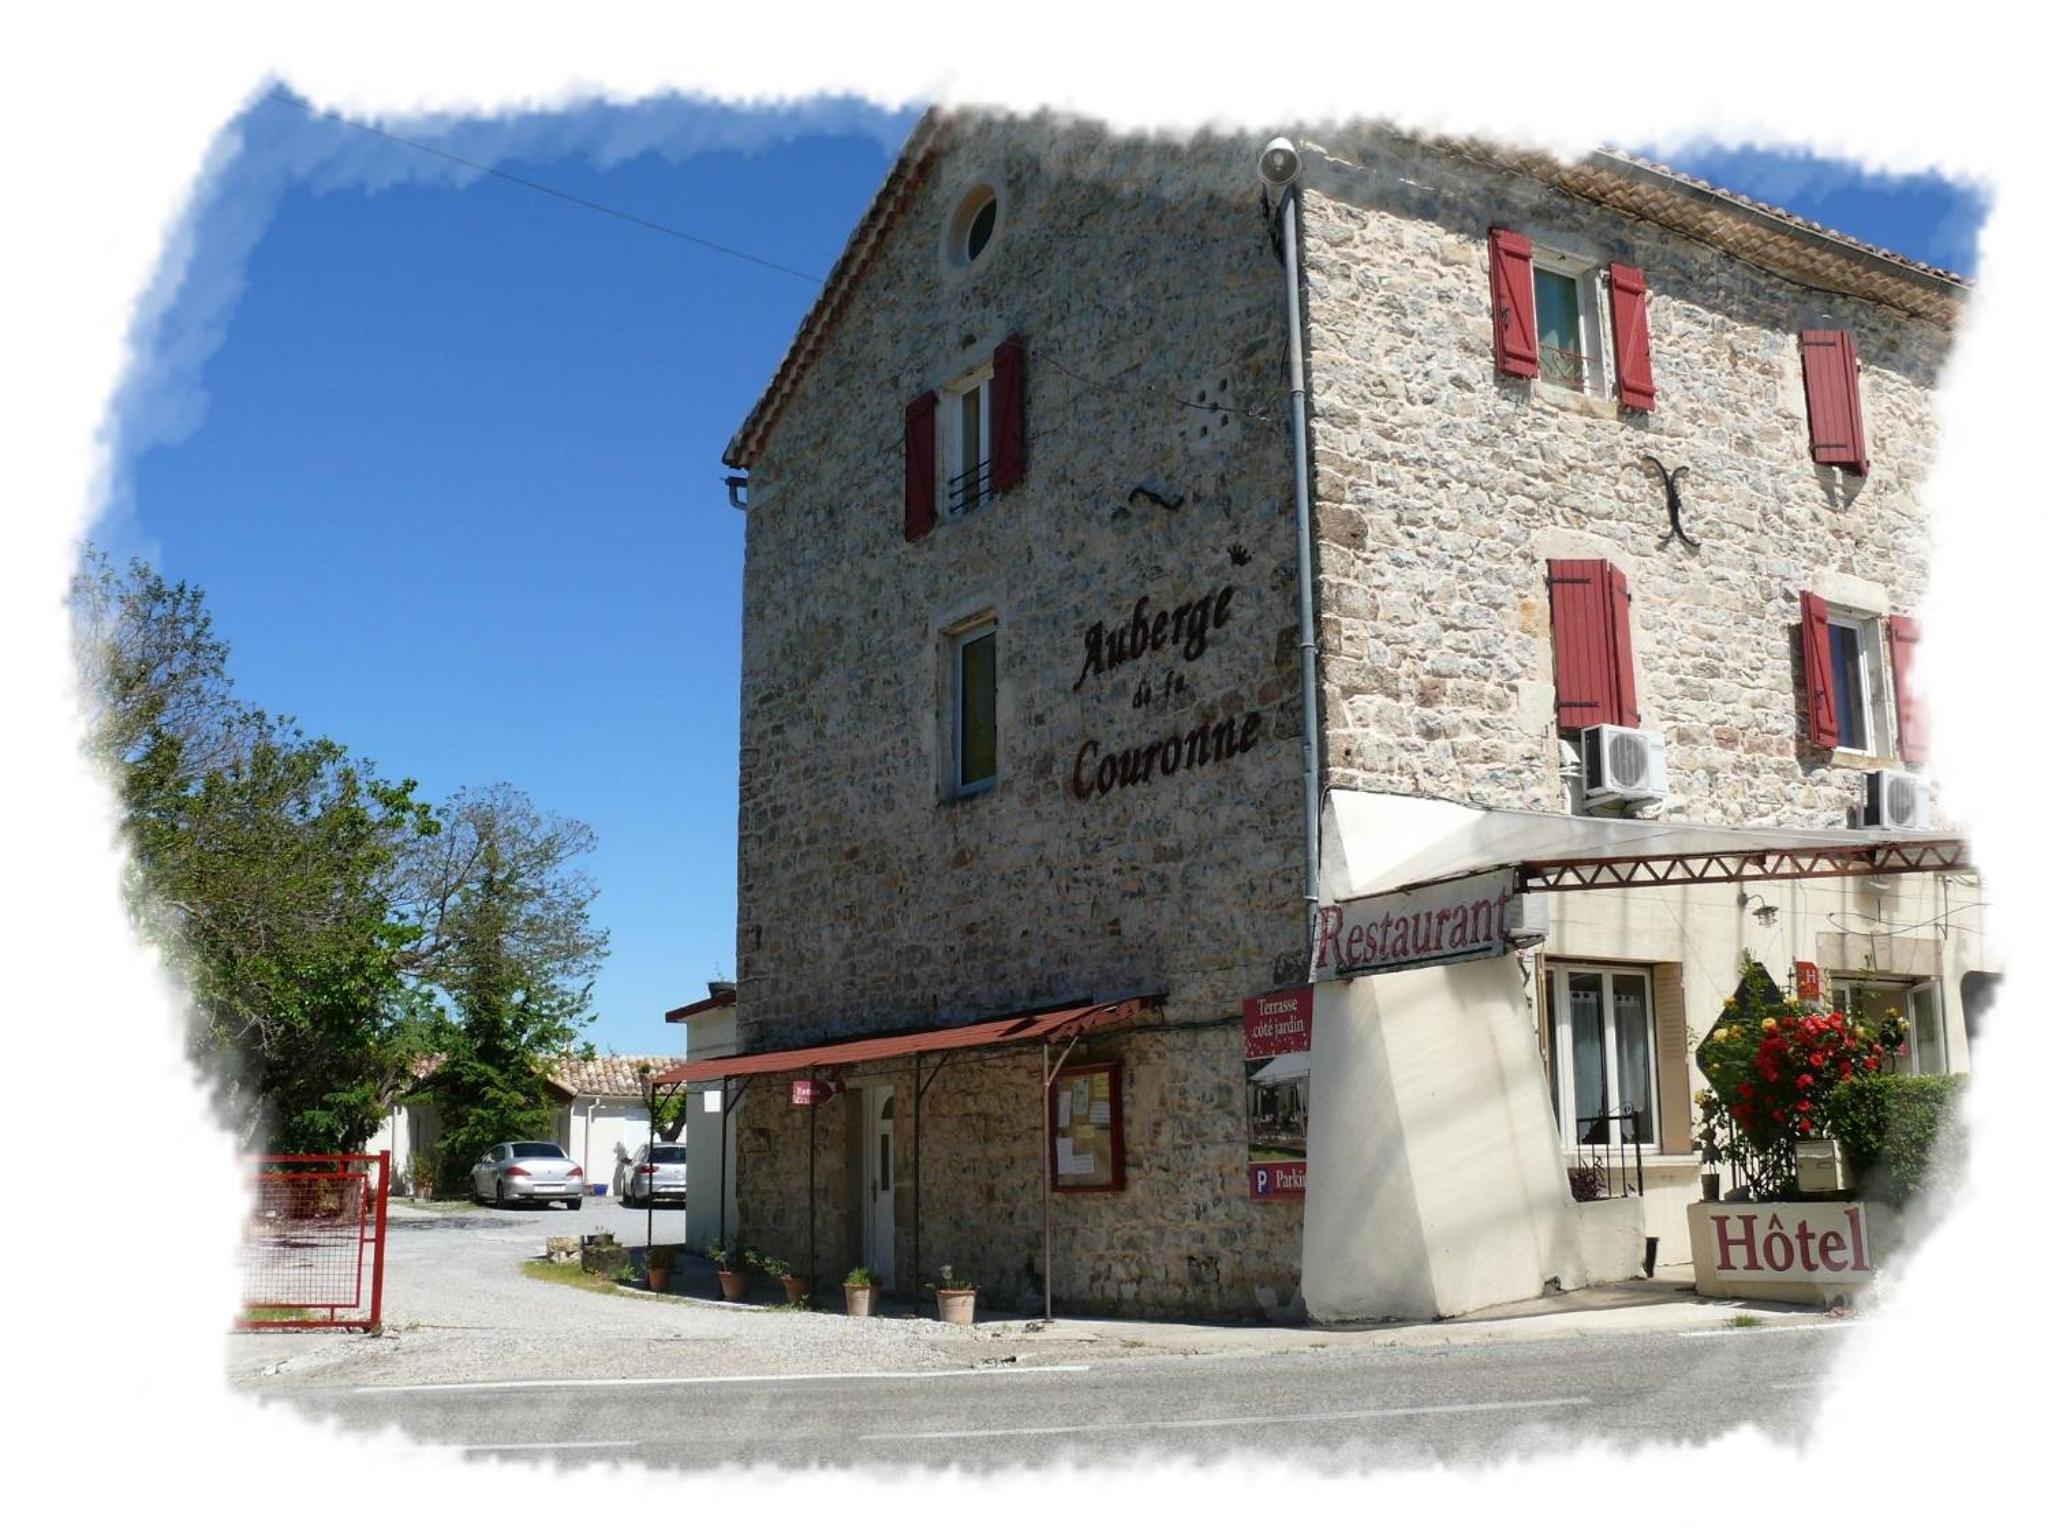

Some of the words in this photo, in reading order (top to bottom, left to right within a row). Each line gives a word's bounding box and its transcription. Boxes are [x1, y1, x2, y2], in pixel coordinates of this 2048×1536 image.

[1072, 585, 1233, 691] Auberge
[1073, 711, 1261, 800] Couronne
[1315, 883, 1511, 969] Restaurant
[1252, 1018, 1273, 1038] côté
[1274, 1014, 1304, 1040] jardin
[1257, 998, 1298, 1017] Terrasse
[1710, 1207, 1870, 1272] Hôtel
